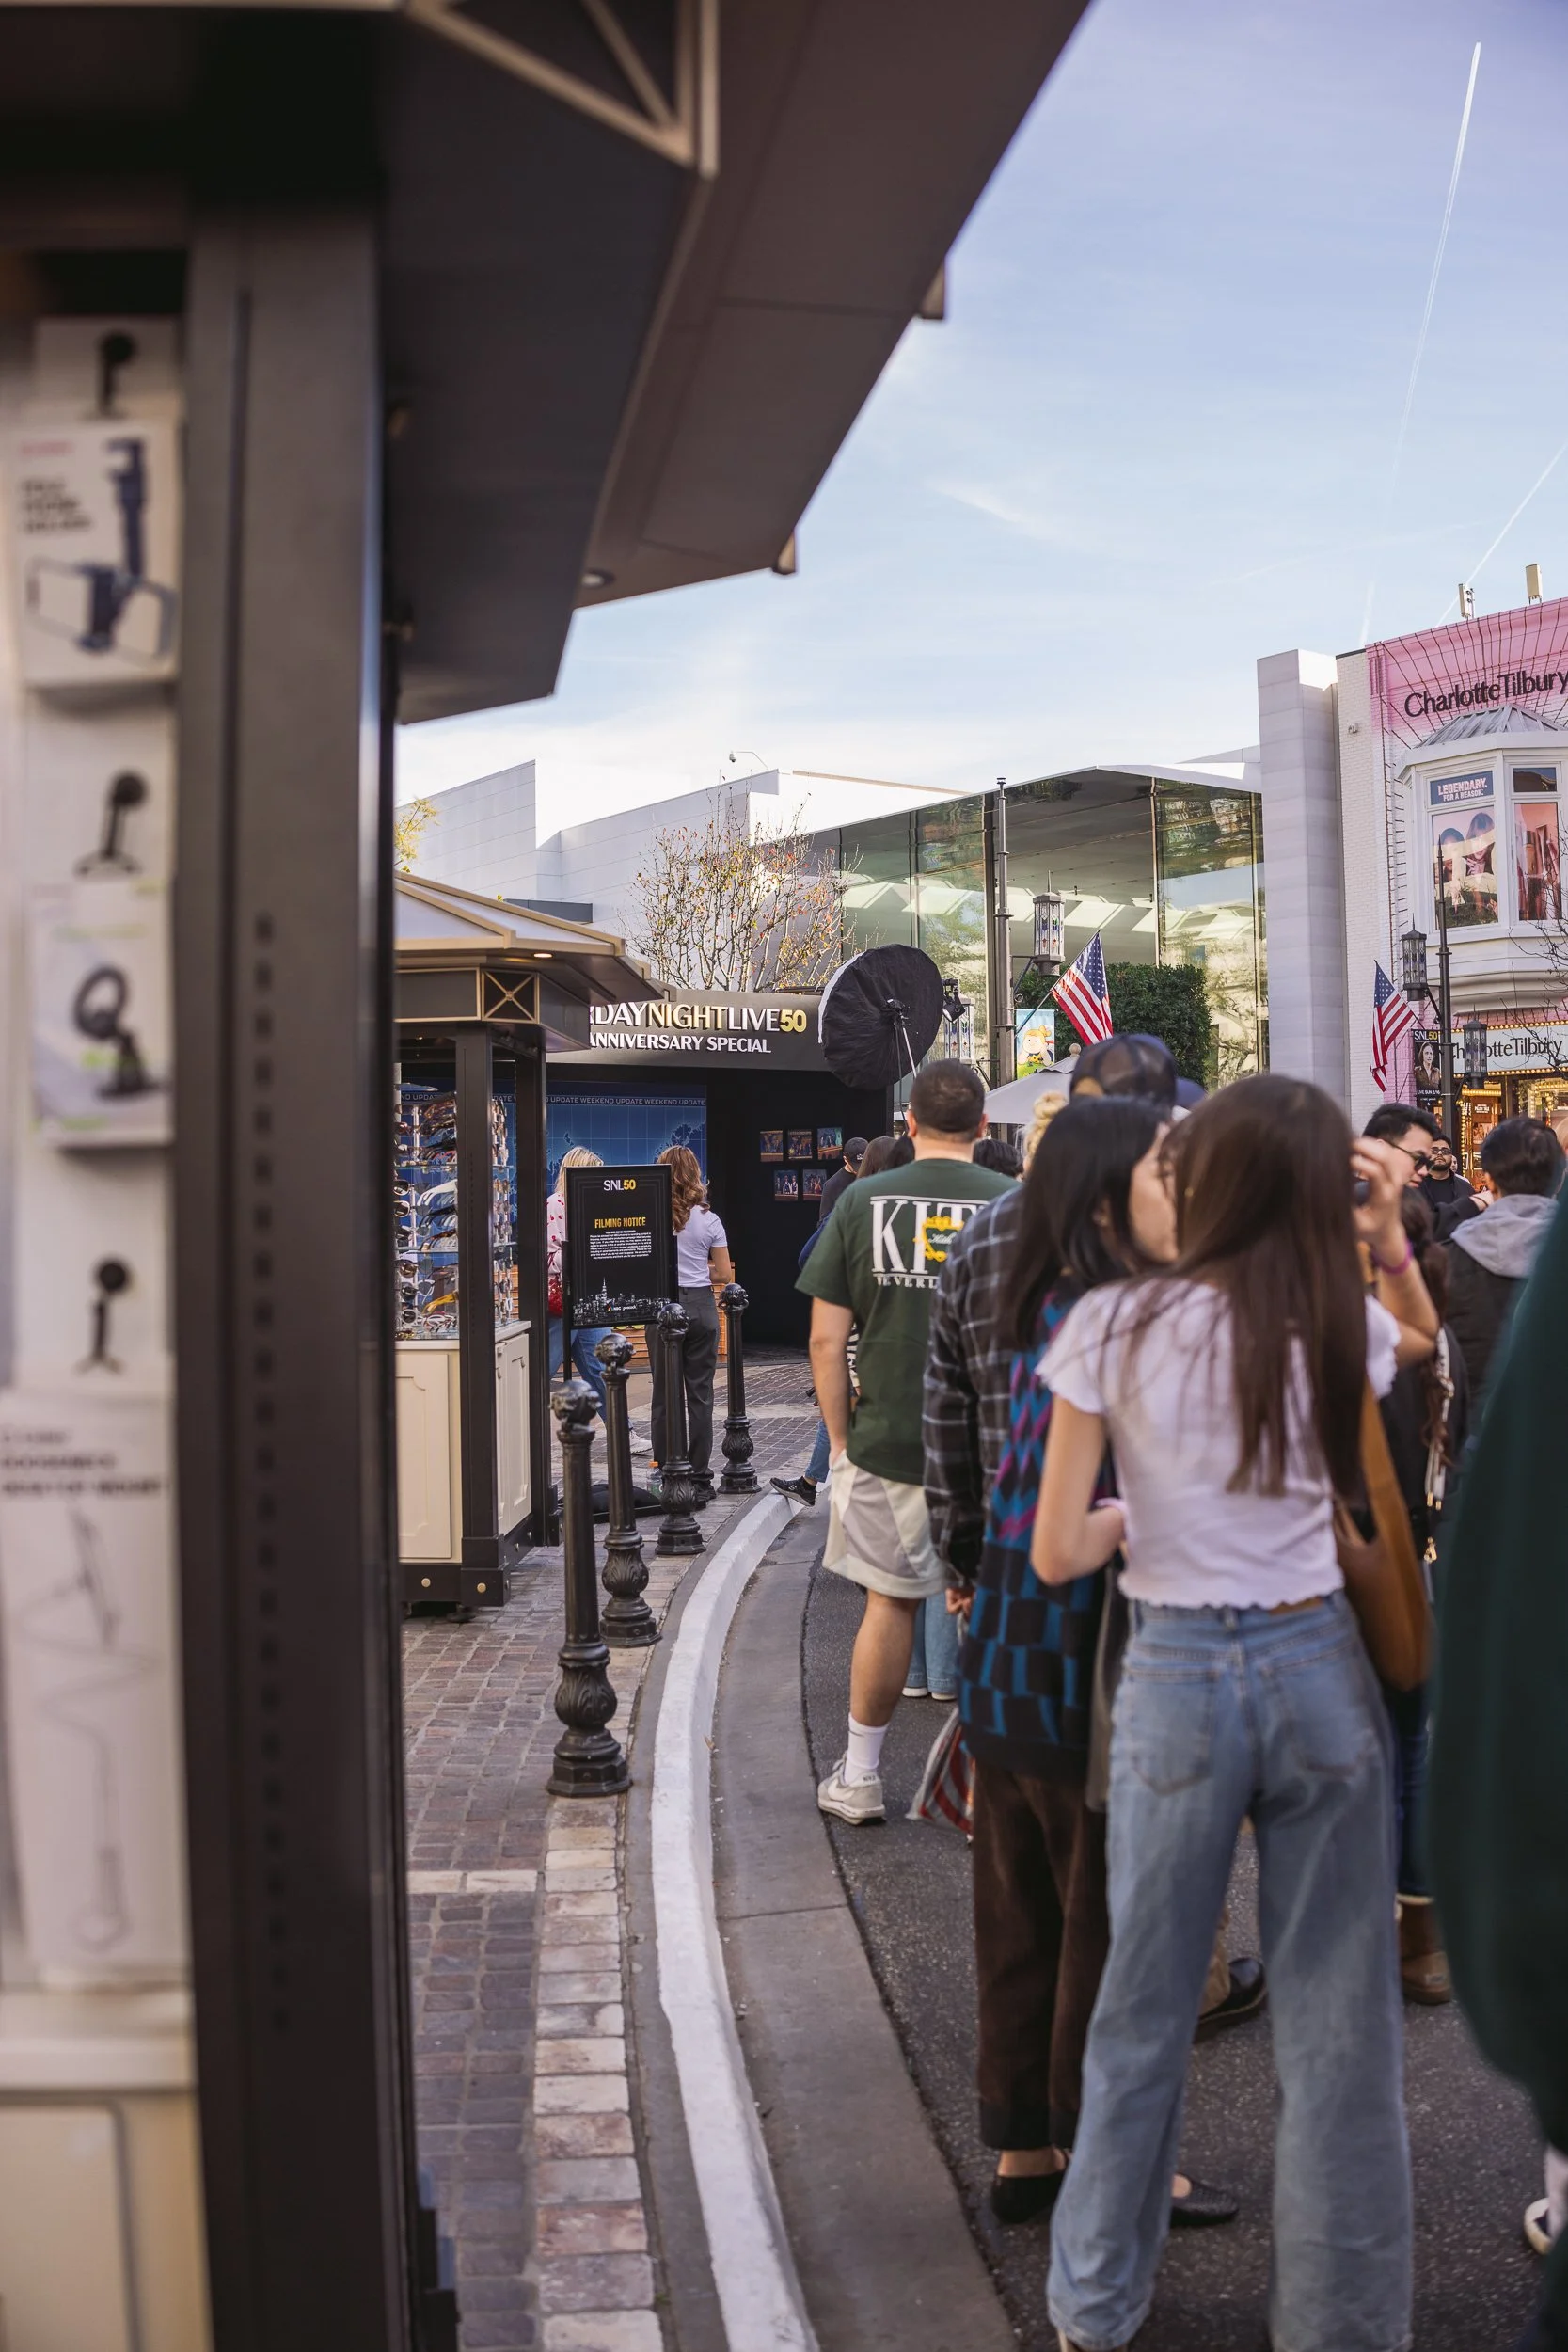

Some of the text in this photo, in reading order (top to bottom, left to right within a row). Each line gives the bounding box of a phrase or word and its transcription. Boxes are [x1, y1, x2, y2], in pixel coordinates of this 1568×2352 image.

[1437, 777, 1487, 796] LEGENDARY.
[1415, 1030, 1438, 1041] SNL50
[706, 1036, 771, 1053] SPECIAL
[603, 1179, 636, 1191] SNL50
[594, 1216, 646, 1229] FILMING NOTICE
[870, 1200, 985, 1274] KIT
